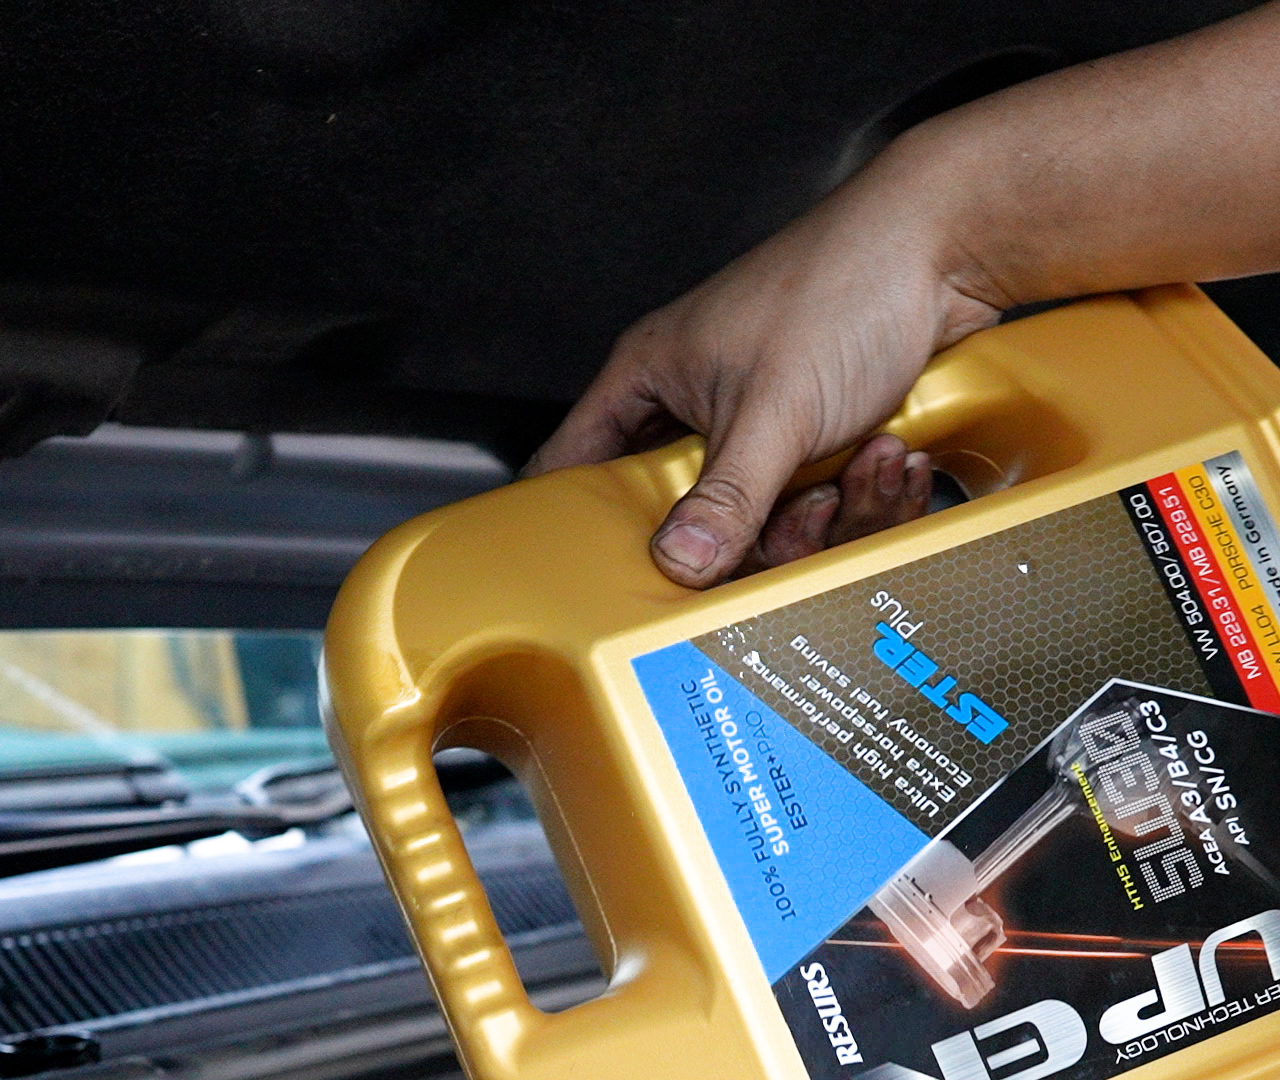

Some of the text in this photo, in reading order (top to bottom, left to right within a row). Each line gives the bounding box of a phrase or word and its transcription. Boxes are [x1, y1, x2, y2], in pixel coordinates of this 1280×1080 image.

[1158, 486, 1199, 545] 229.51
[1188, 475, 1215, 510] C30
[1216, 465, 1262, 544] Germany
[1129, 493, 1219, 661] VW 504.00/507.00
[1206, 515, 1254, 591] PORSCHE
[1256, 547, 1272, 565] in
[870, 590, 924, 639] Plus
[1237, 648, 1262, 680] MB
[742, 651, 940, 818] Ultra high performance
[790, 635, 972, 788] Economy fuel saving
[799, 674, 957, 803] Extra horsepower
[872, 621, 1009, 745] ESTER
[681, 679, 797, 921] 100% FULLY SYNTHETIC
[699, 668, 790, 857] SUPER MOTOR OIL
[745, 710, 808, 830] ESTER+PAO
[1139, 700, 1231, 876] ACEA A3/B4/C3
[1186, 729, 1250, 845] API SN/CG
[1070, 761, 1144, 910] HTHS Enhancement
[799, 961, 864, 1066] RESURS
[1114, 997, 1256, 1064] TECHNOLOGY
